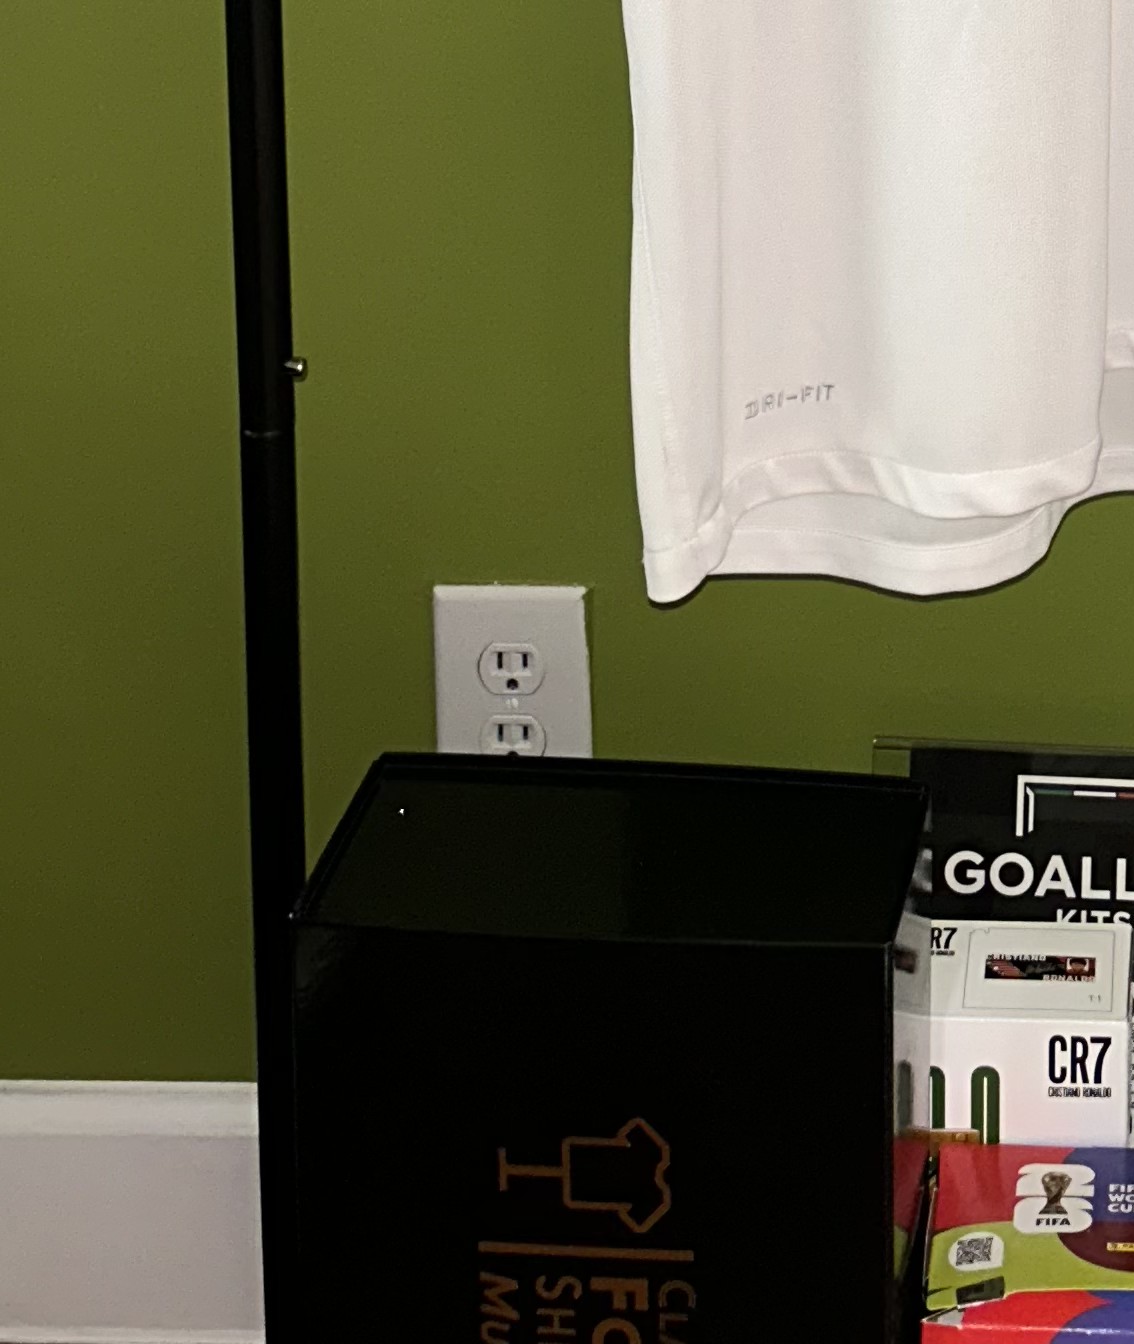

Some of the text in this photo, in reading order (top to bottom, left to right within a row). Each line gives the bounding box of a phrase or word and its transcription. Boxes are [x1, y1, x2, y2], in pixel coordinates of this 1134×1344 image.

[744, 383, 836, 421] DRI-FIT
[930, 926, 958, 950] R7
[1048, 1034, 1112, 1084] CR7
[1034, 1217, 1072, 1227] FIFA
